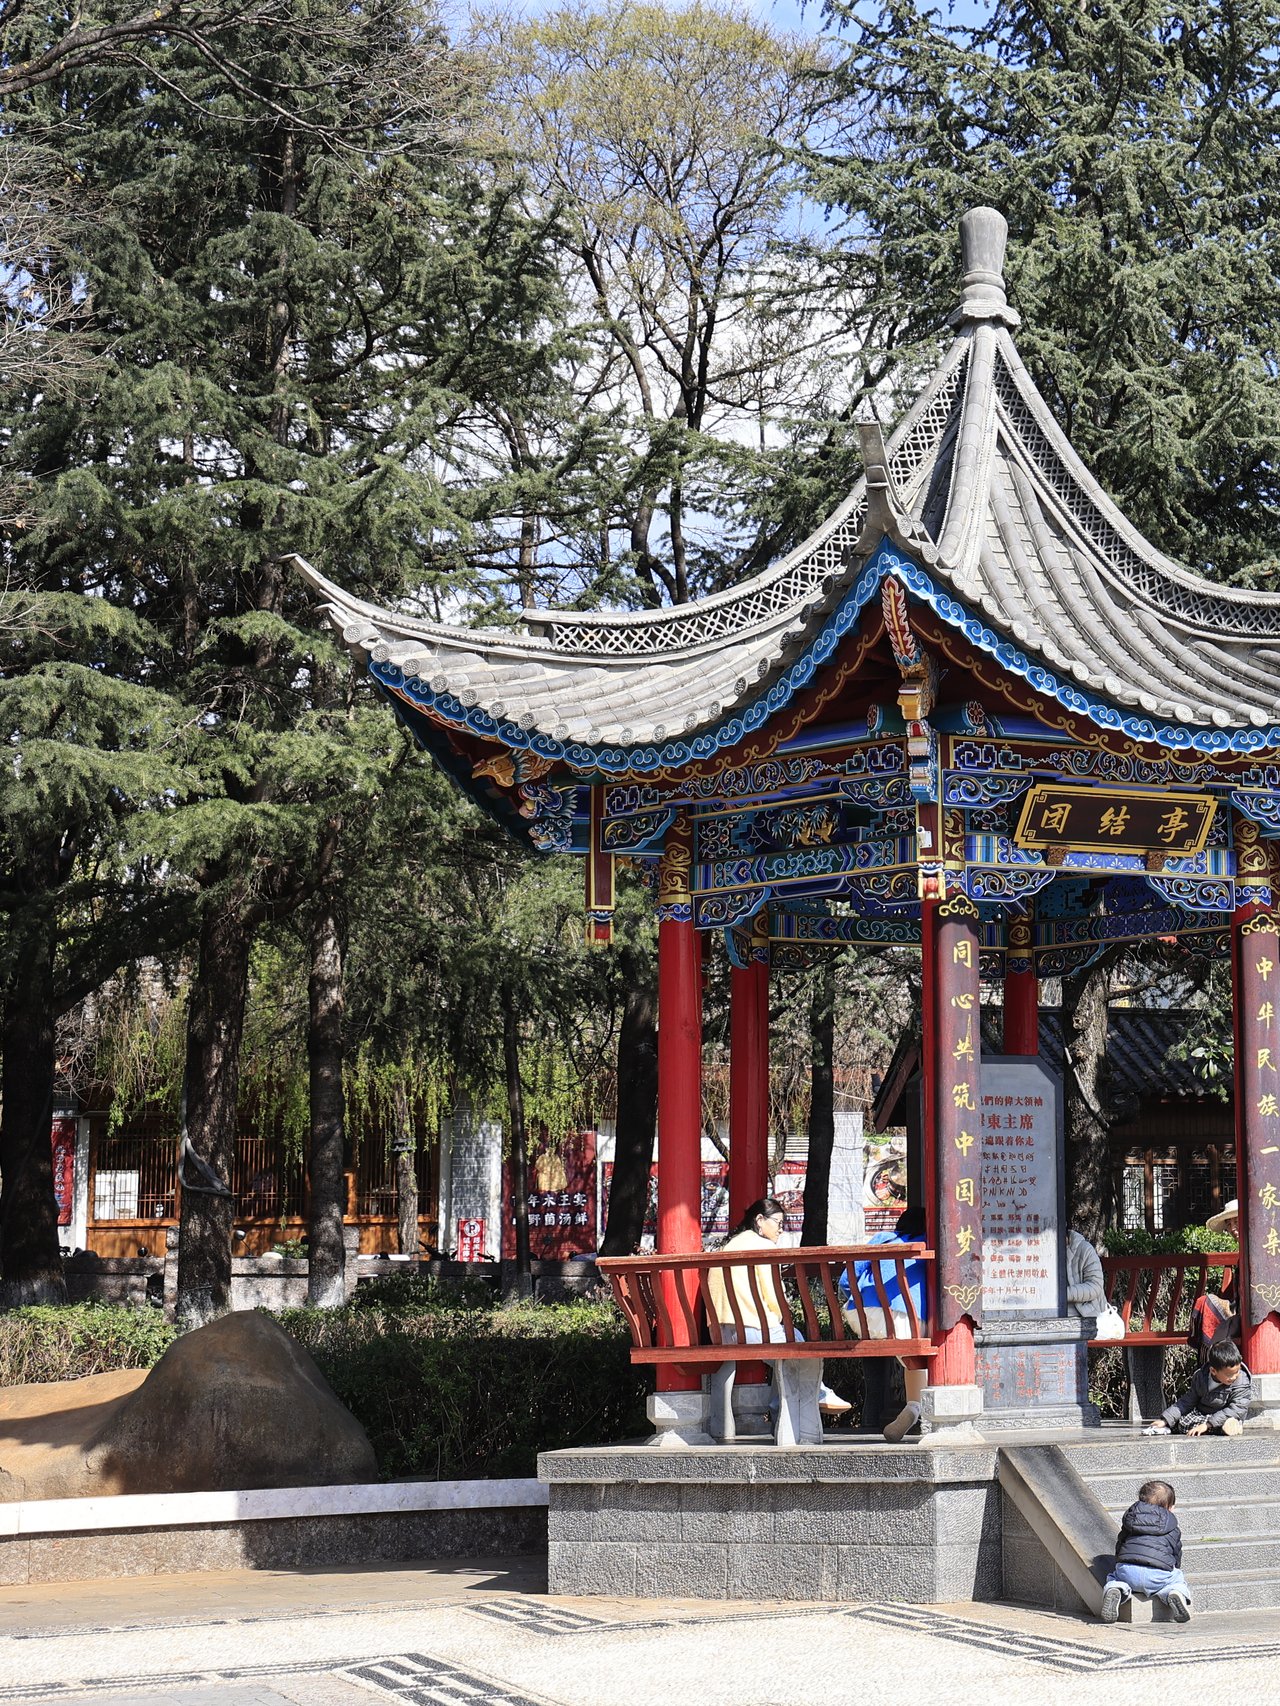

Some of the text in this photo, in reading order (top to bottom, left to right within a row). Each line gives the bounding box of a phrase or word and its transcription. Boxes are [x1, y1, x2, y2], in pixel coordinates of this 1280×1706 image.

[1040, 803, 1189, 843] 团结亭
[951, 940, 976, 1257] 同心共筑中国梦
[982, 1136, 1034, 1146] 遠跟着你走
[512, 1193, 587, 1207] 年木王宴
[512, 1212, 588, 1226] 野菌汤鲜
